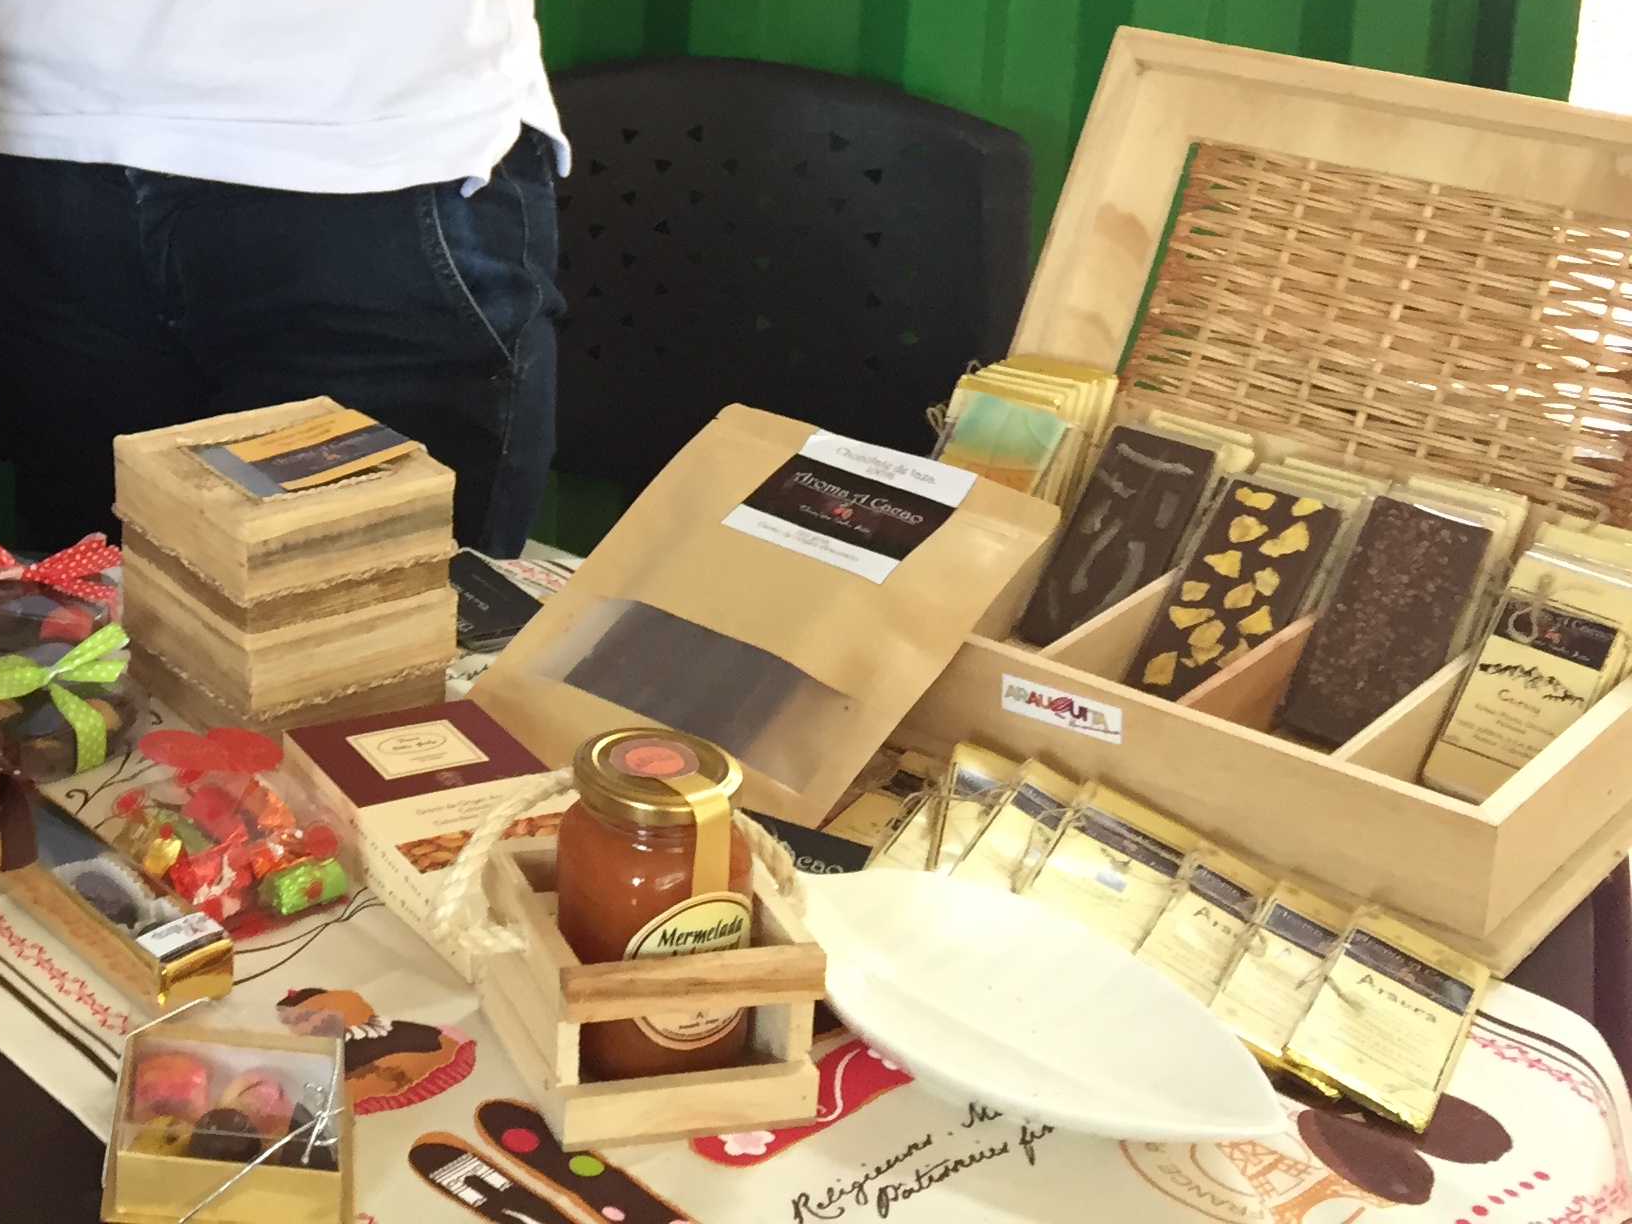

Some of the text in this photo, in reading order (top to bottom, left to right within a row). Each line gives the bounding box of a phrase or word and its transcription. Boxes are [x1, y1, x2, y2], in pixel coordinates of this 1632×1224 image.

[793, 472, 849, 497] Aroma
[870, 498, 924, 524] Cacao
[657, 915, 744, 948] Mermelada
